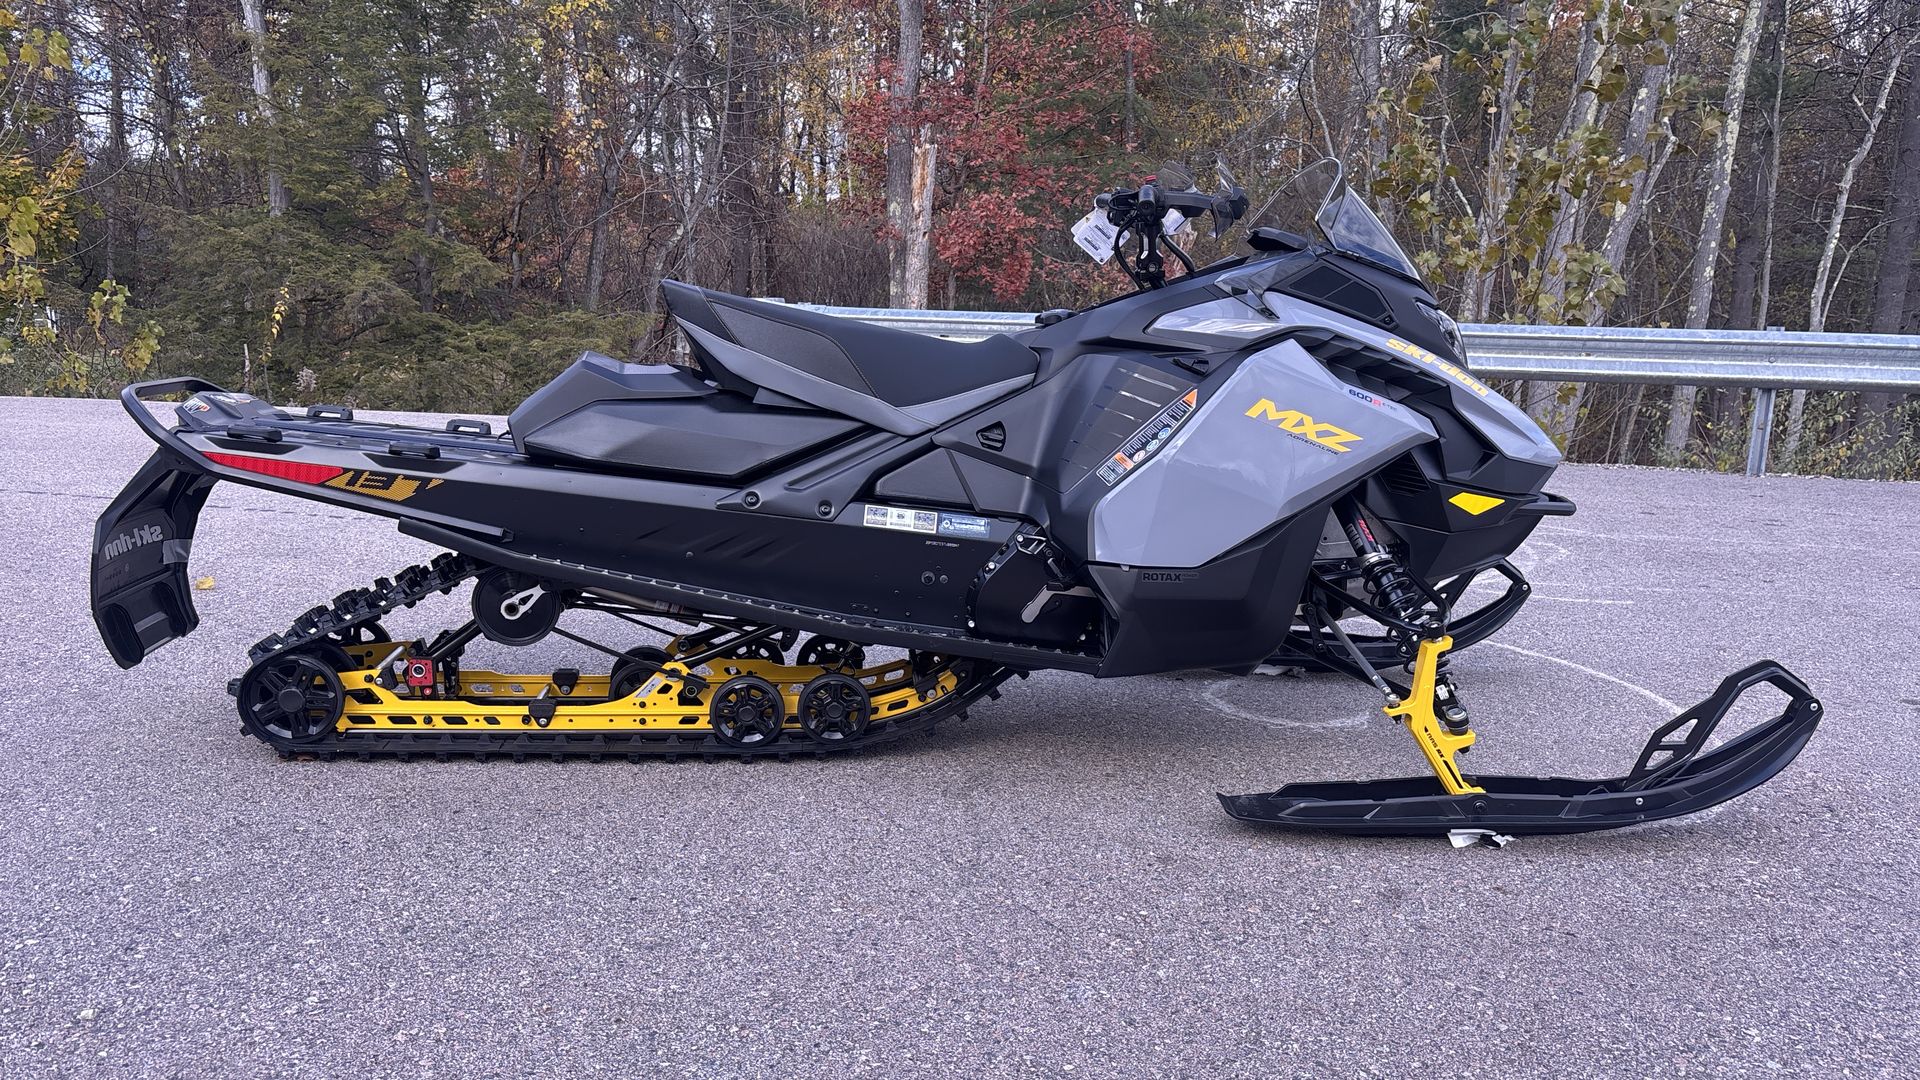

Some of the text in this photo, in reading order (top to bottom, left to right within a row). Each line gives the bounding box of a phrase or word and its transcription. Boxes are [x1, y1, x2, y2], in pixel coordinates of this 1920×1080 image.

[1348, 389, 1382, 407] 600R
[1244, 398, 1364, 453] MXZ
[1286, 433, 1340, 456] ADRENALINE
[1143, 572, 1182, 582] ROTAX
